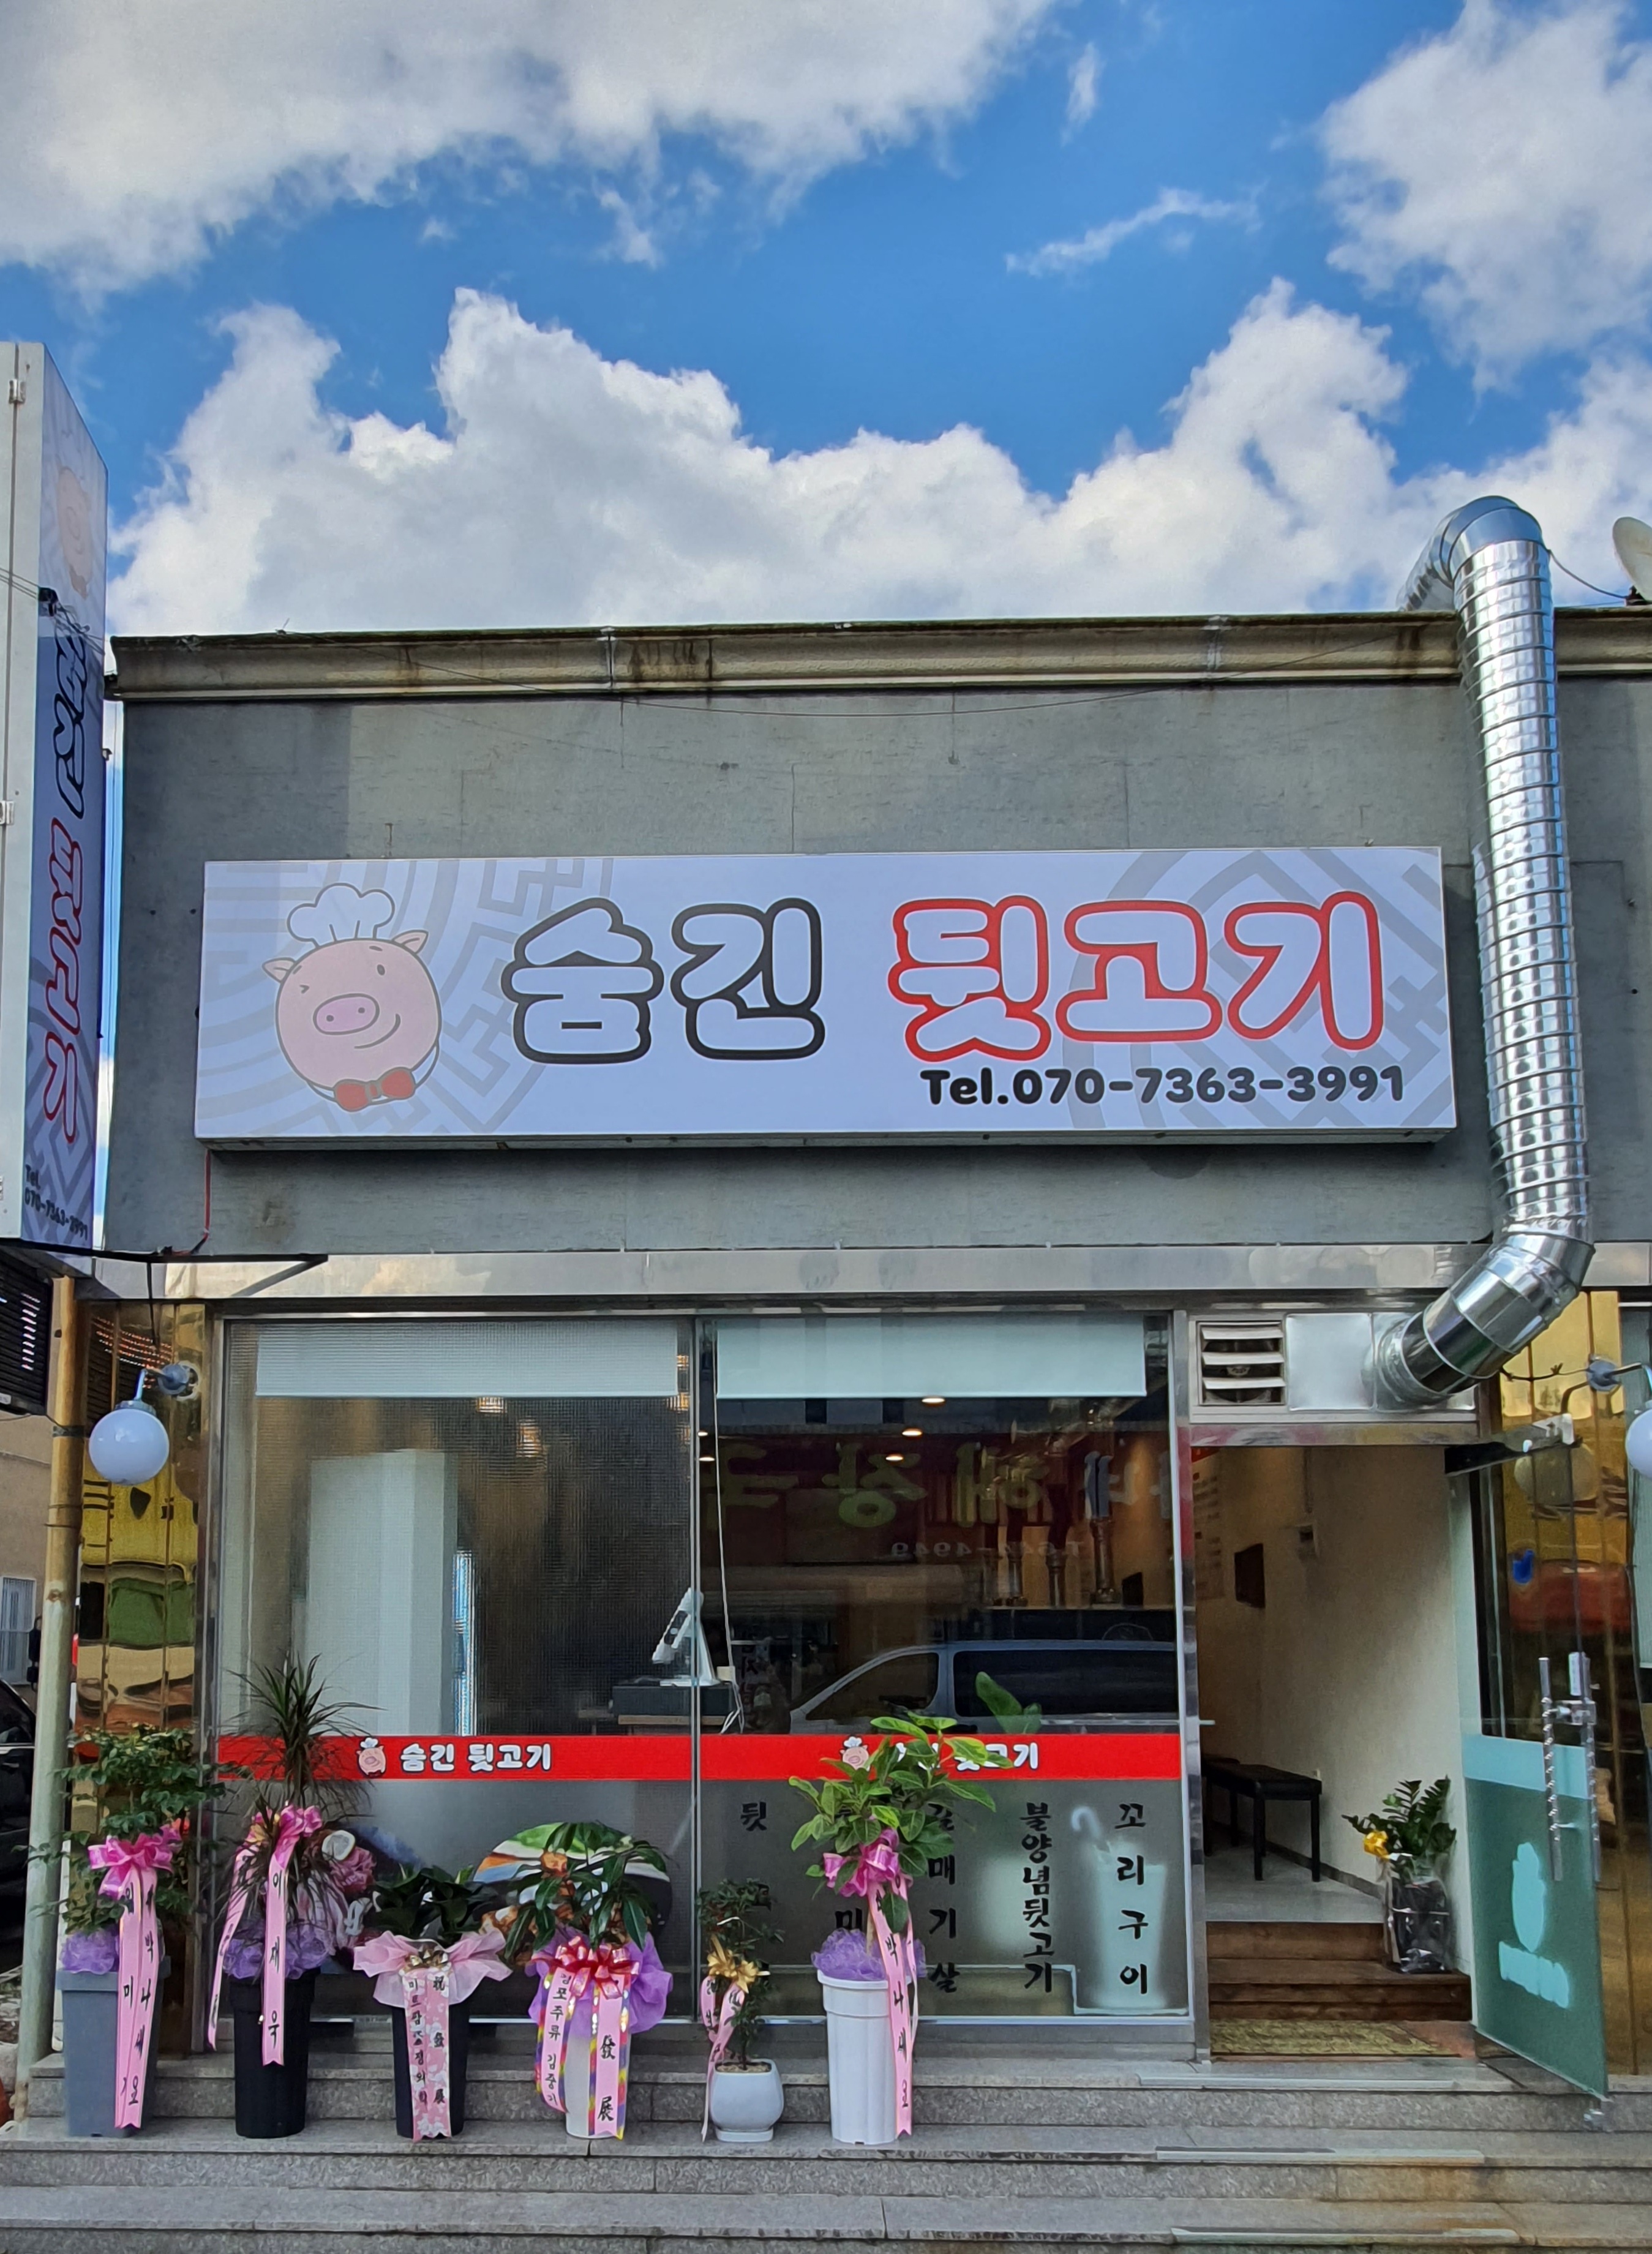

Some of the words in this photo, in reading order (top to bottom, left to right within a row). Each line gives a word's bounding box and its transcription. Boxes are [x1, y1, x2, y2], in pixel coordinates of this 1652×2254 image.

[501, 897, 825, 1064] 숨긴
[888, 891, 1384, 1062] 뒷고기
[920, 1065, 1403, 1105] Tel.070-7363-3991
[400, 1743, 455, 1771] 숨긴
[468, 1743, 551, 1771] 뒷고기
[1114, 1803, 1148, 1994] 꼬리구이
